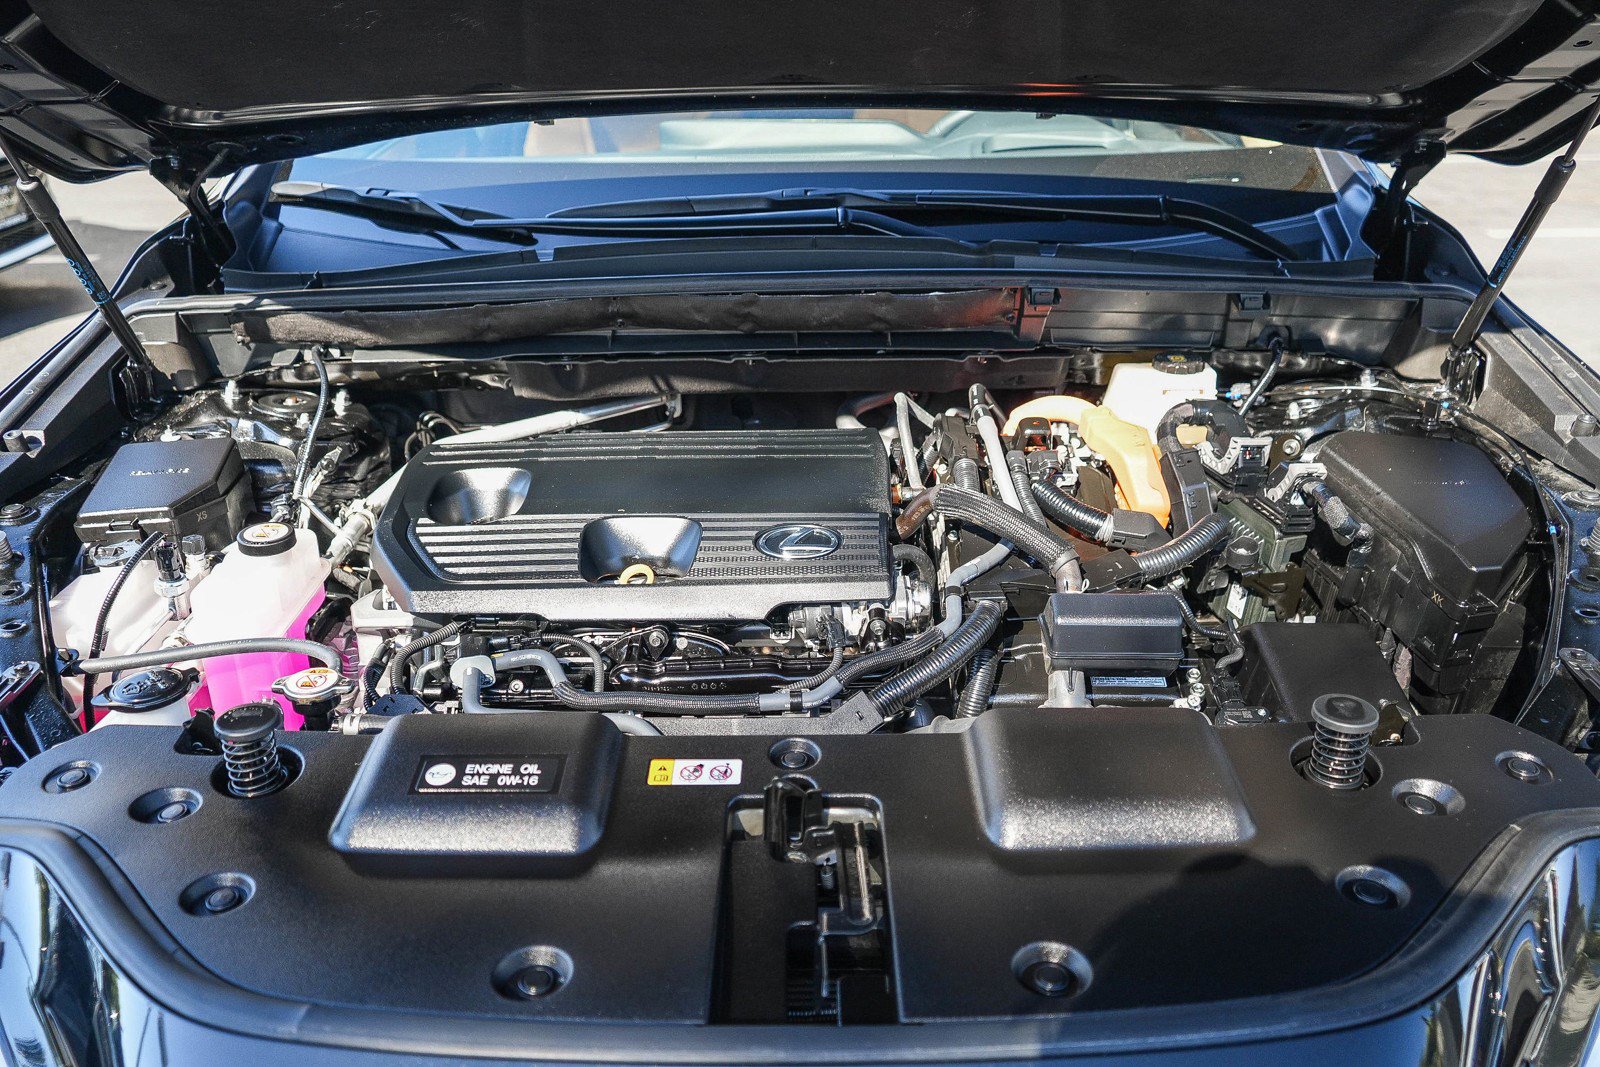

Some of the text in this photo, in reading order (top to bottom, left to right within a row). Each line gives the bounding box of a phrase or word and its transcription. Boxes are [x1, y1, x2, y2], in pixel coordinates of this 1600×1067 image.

[464, 763, 542, 775] ENGINE OIL
[461, 775, 539, 786] SAE 0W-16
